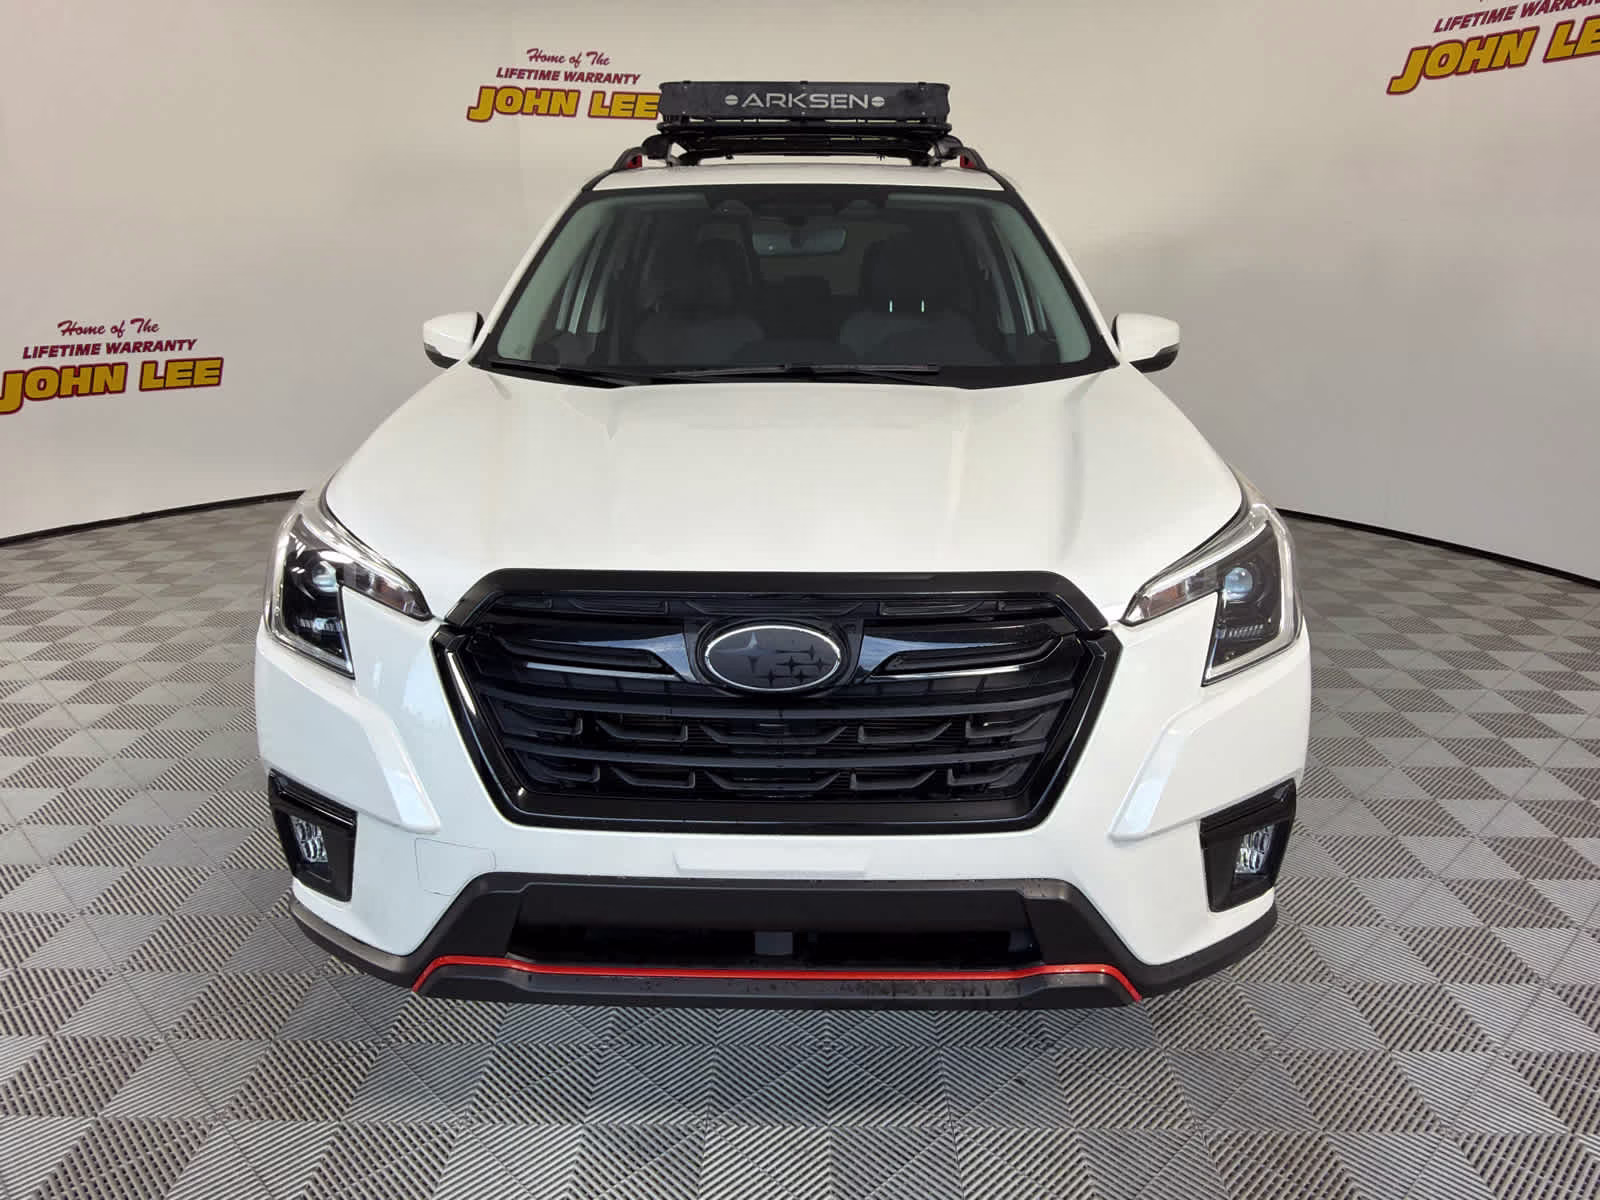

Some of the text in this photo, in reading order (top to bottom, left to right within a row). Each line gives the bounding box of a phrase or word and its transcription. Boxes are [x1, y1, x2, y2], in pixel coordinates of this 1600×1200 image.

[1433, 5, 1518, 33] LIFETIME
[526, 48, 610, 68] Home of The
[1386, 26, 1540, 95] JOHN
[496, 67, 641, 85] LIFETIME WARRANTY
[466, 86, 661, 123] JOHN LEE
[741, 92, 869, 109] ARKSEN
[57, 318, 160, 338] Home of The
[22, 338, 198, 359] LIFETIME WARRANTY
[0, 357, 224, 415] JOHN LEE
